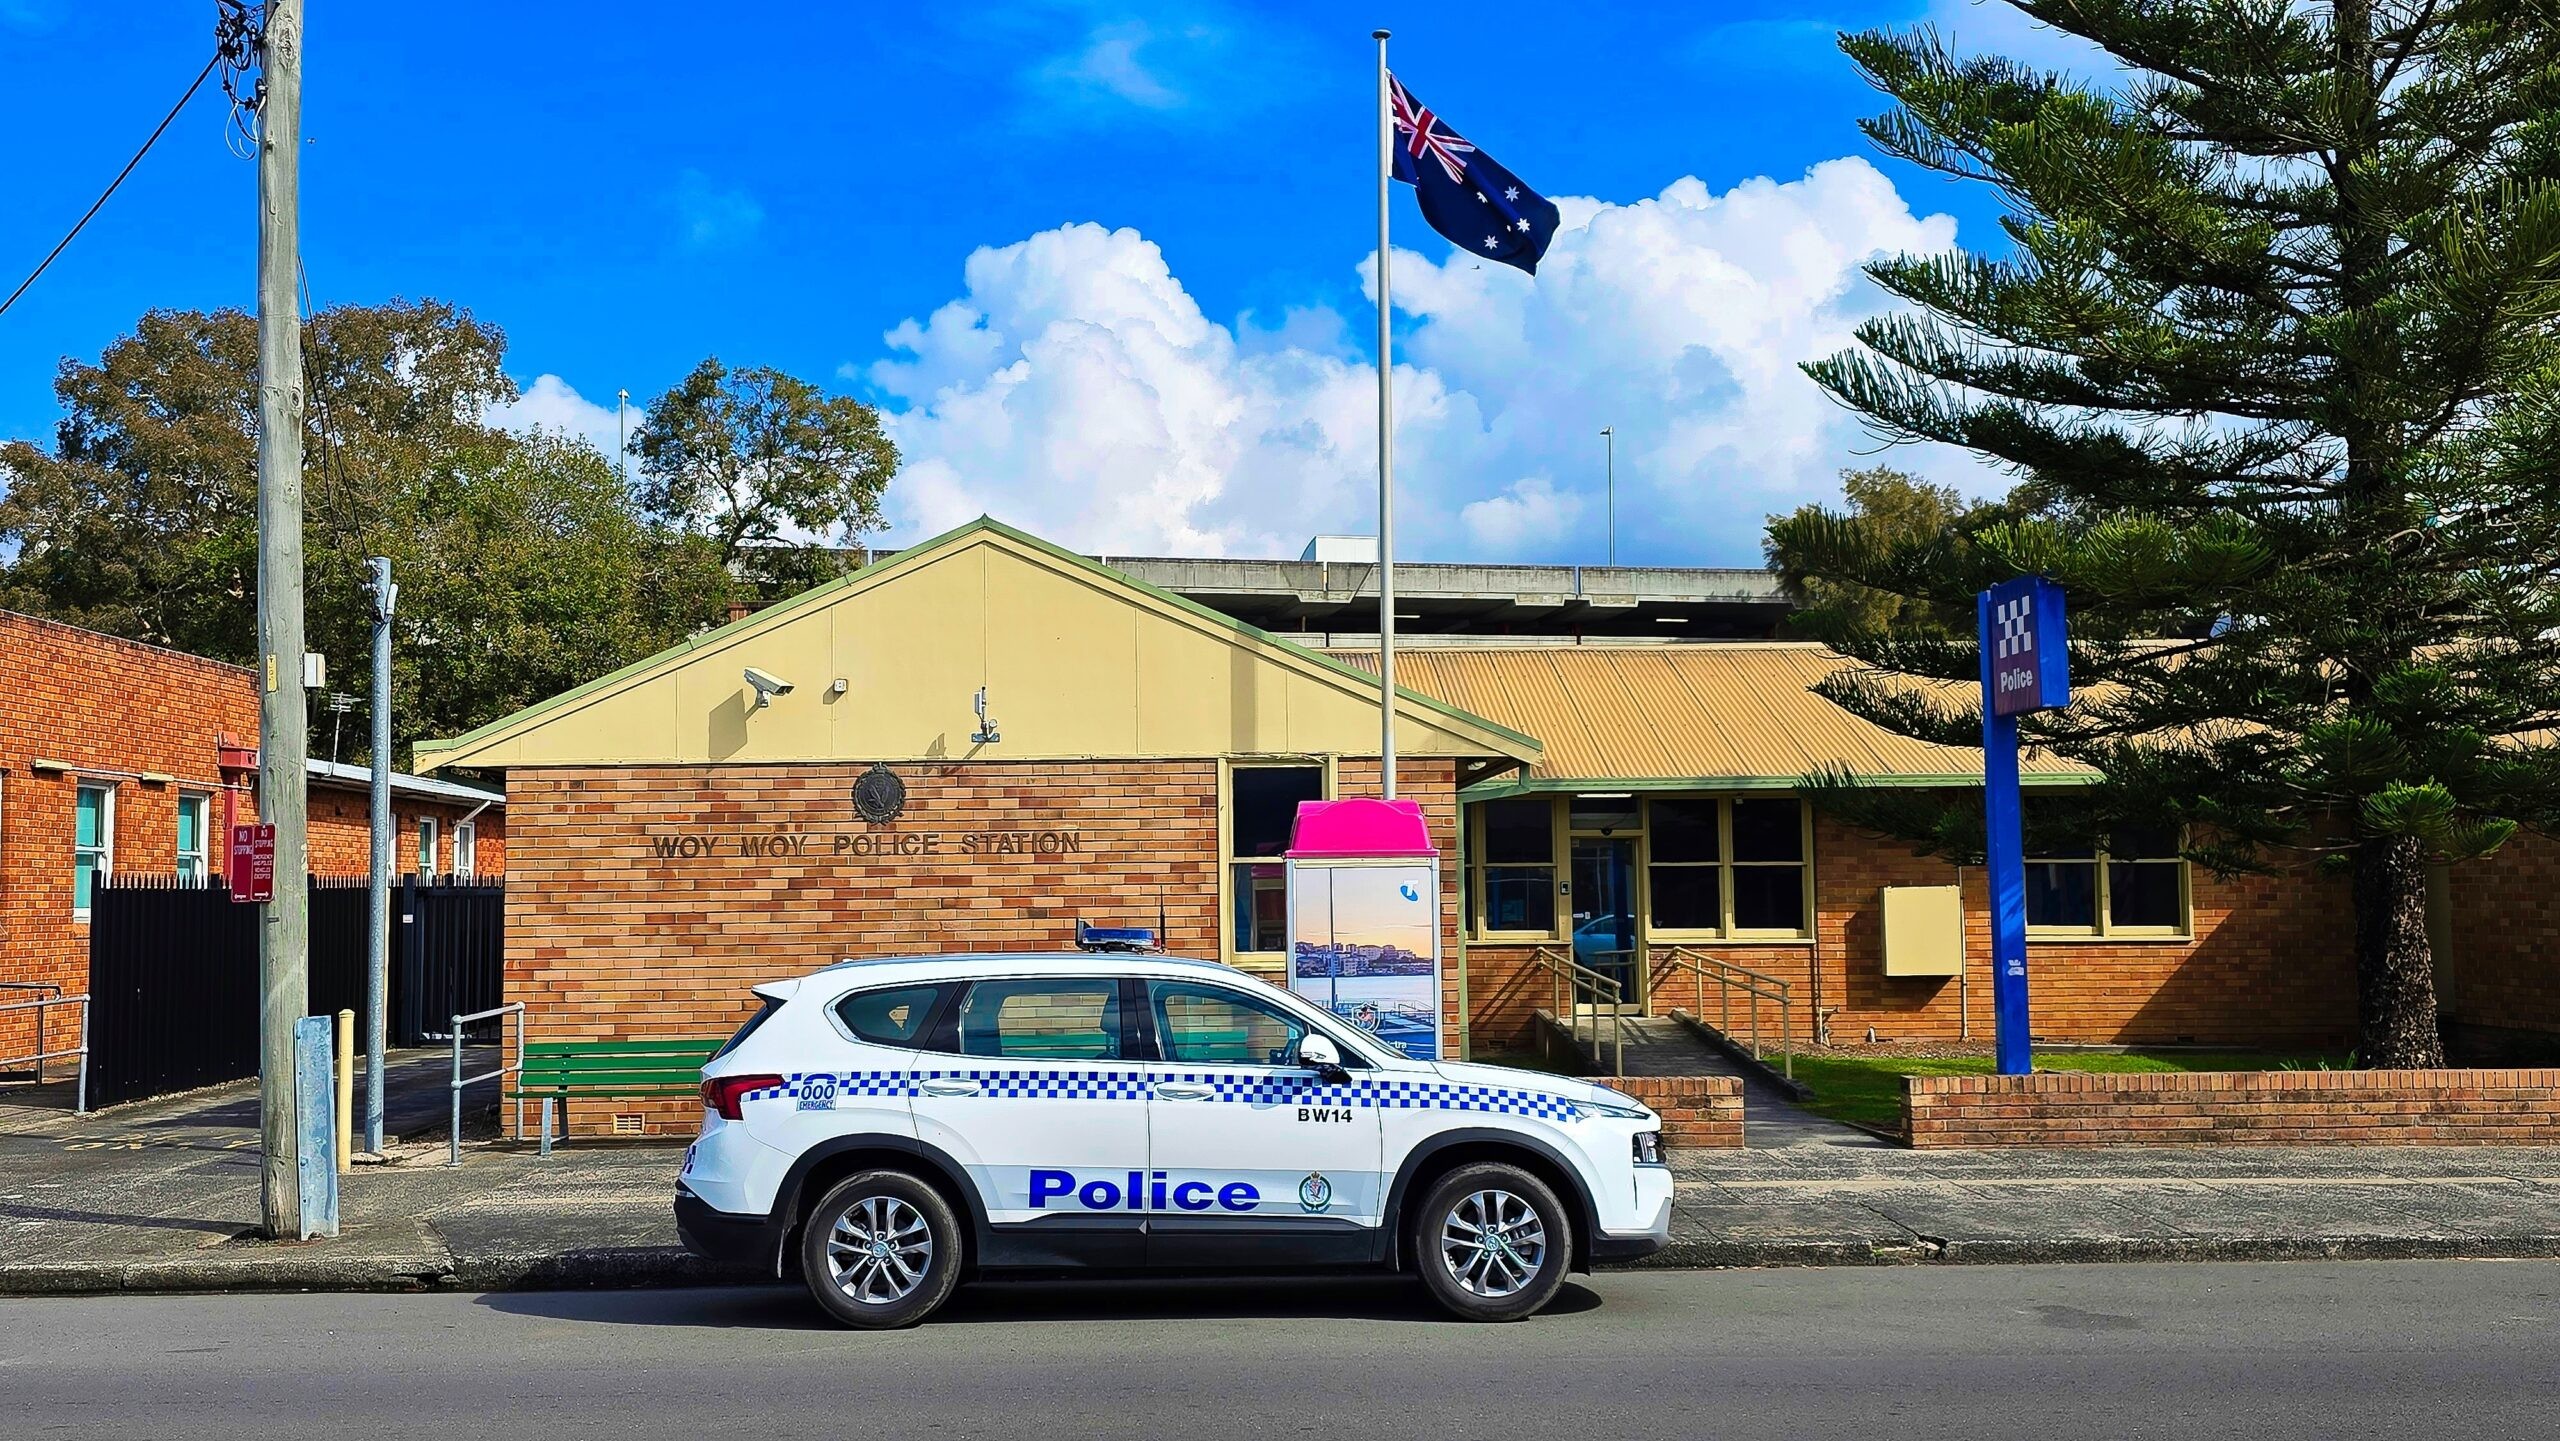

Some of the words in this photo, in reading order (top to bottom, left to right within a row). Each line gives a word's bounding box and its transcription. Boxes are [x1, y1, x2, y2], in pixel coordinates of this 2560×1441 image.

[2000, 667, 2033, 693] Police
[238, 830, 248, 842] NO
[260, 829, 268, 838] NO
[234, 845, 253, 855] STOPPING
[255, 839, 274, 848] STOPPING
[653, 836, 719, 858] WOY
[741, 835, 808, 857] WOY
[834, 833, 940, 856] POLICE
[961, 832, 1080, 854] STATION
[801, 1085, 835, 1100] 000
[800, 1100, 834, 1111] EMERGENCY
[1297, 1108, 1353, 1123] BW14
[1028, 1169, 1261, 1212] Police
